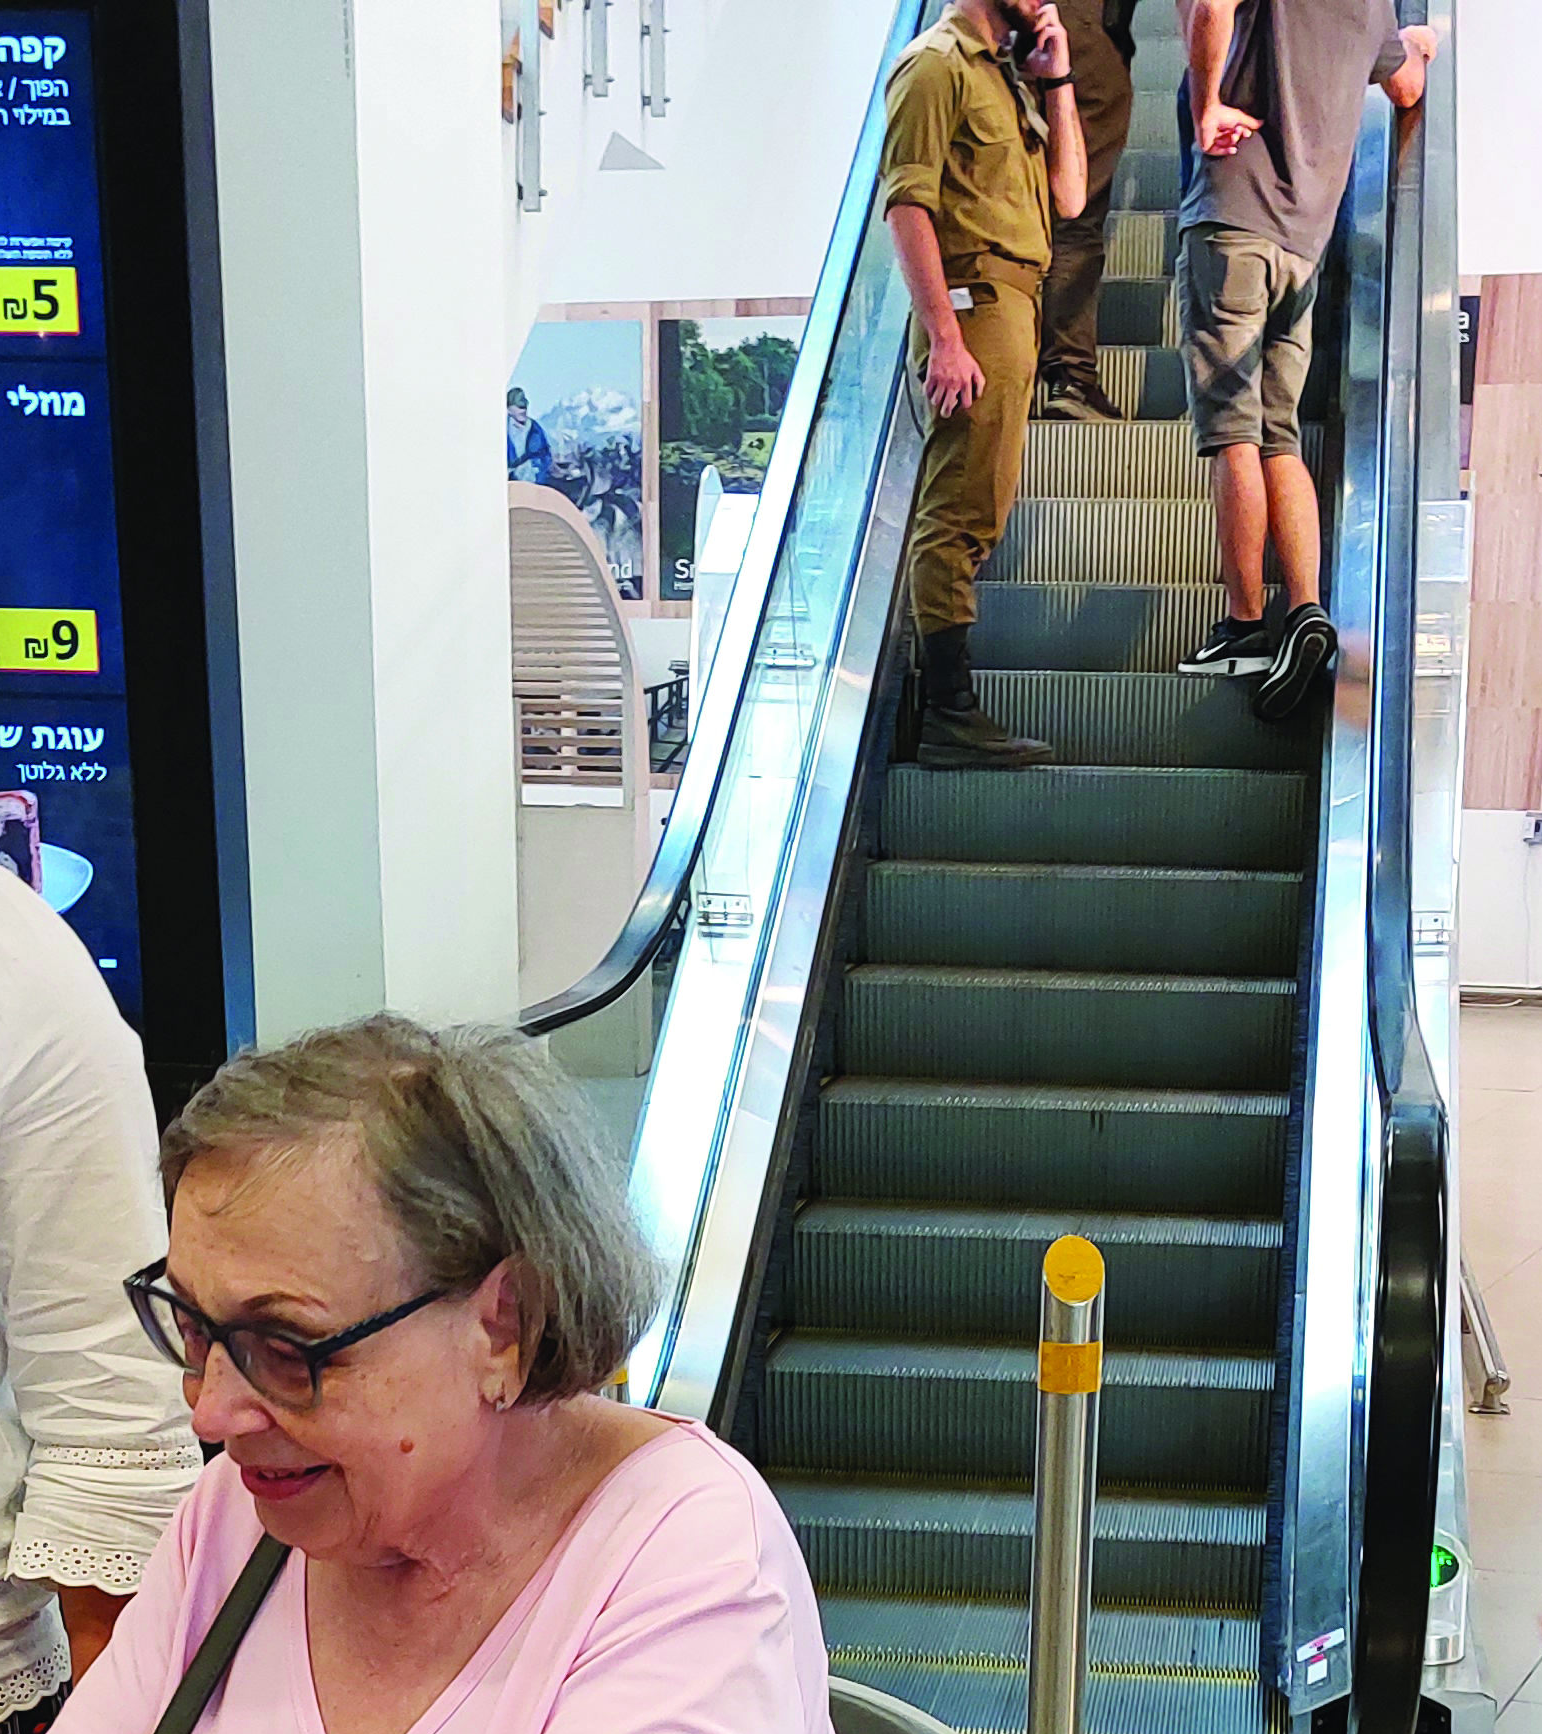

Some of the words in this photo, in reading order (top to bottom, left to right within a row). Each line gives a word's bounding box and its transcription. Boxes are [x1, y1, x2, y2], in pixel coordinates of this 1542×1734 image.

[20, 78, 70, 101] הפוך
[12, 103, 72, 126] במילוי
[6, 384, 86, 417] מוזלי
[30, 726, 105, 752] עוגת
[15, 761, 66, 784] גלוטן
[70, 761, 108, 783] ללא
